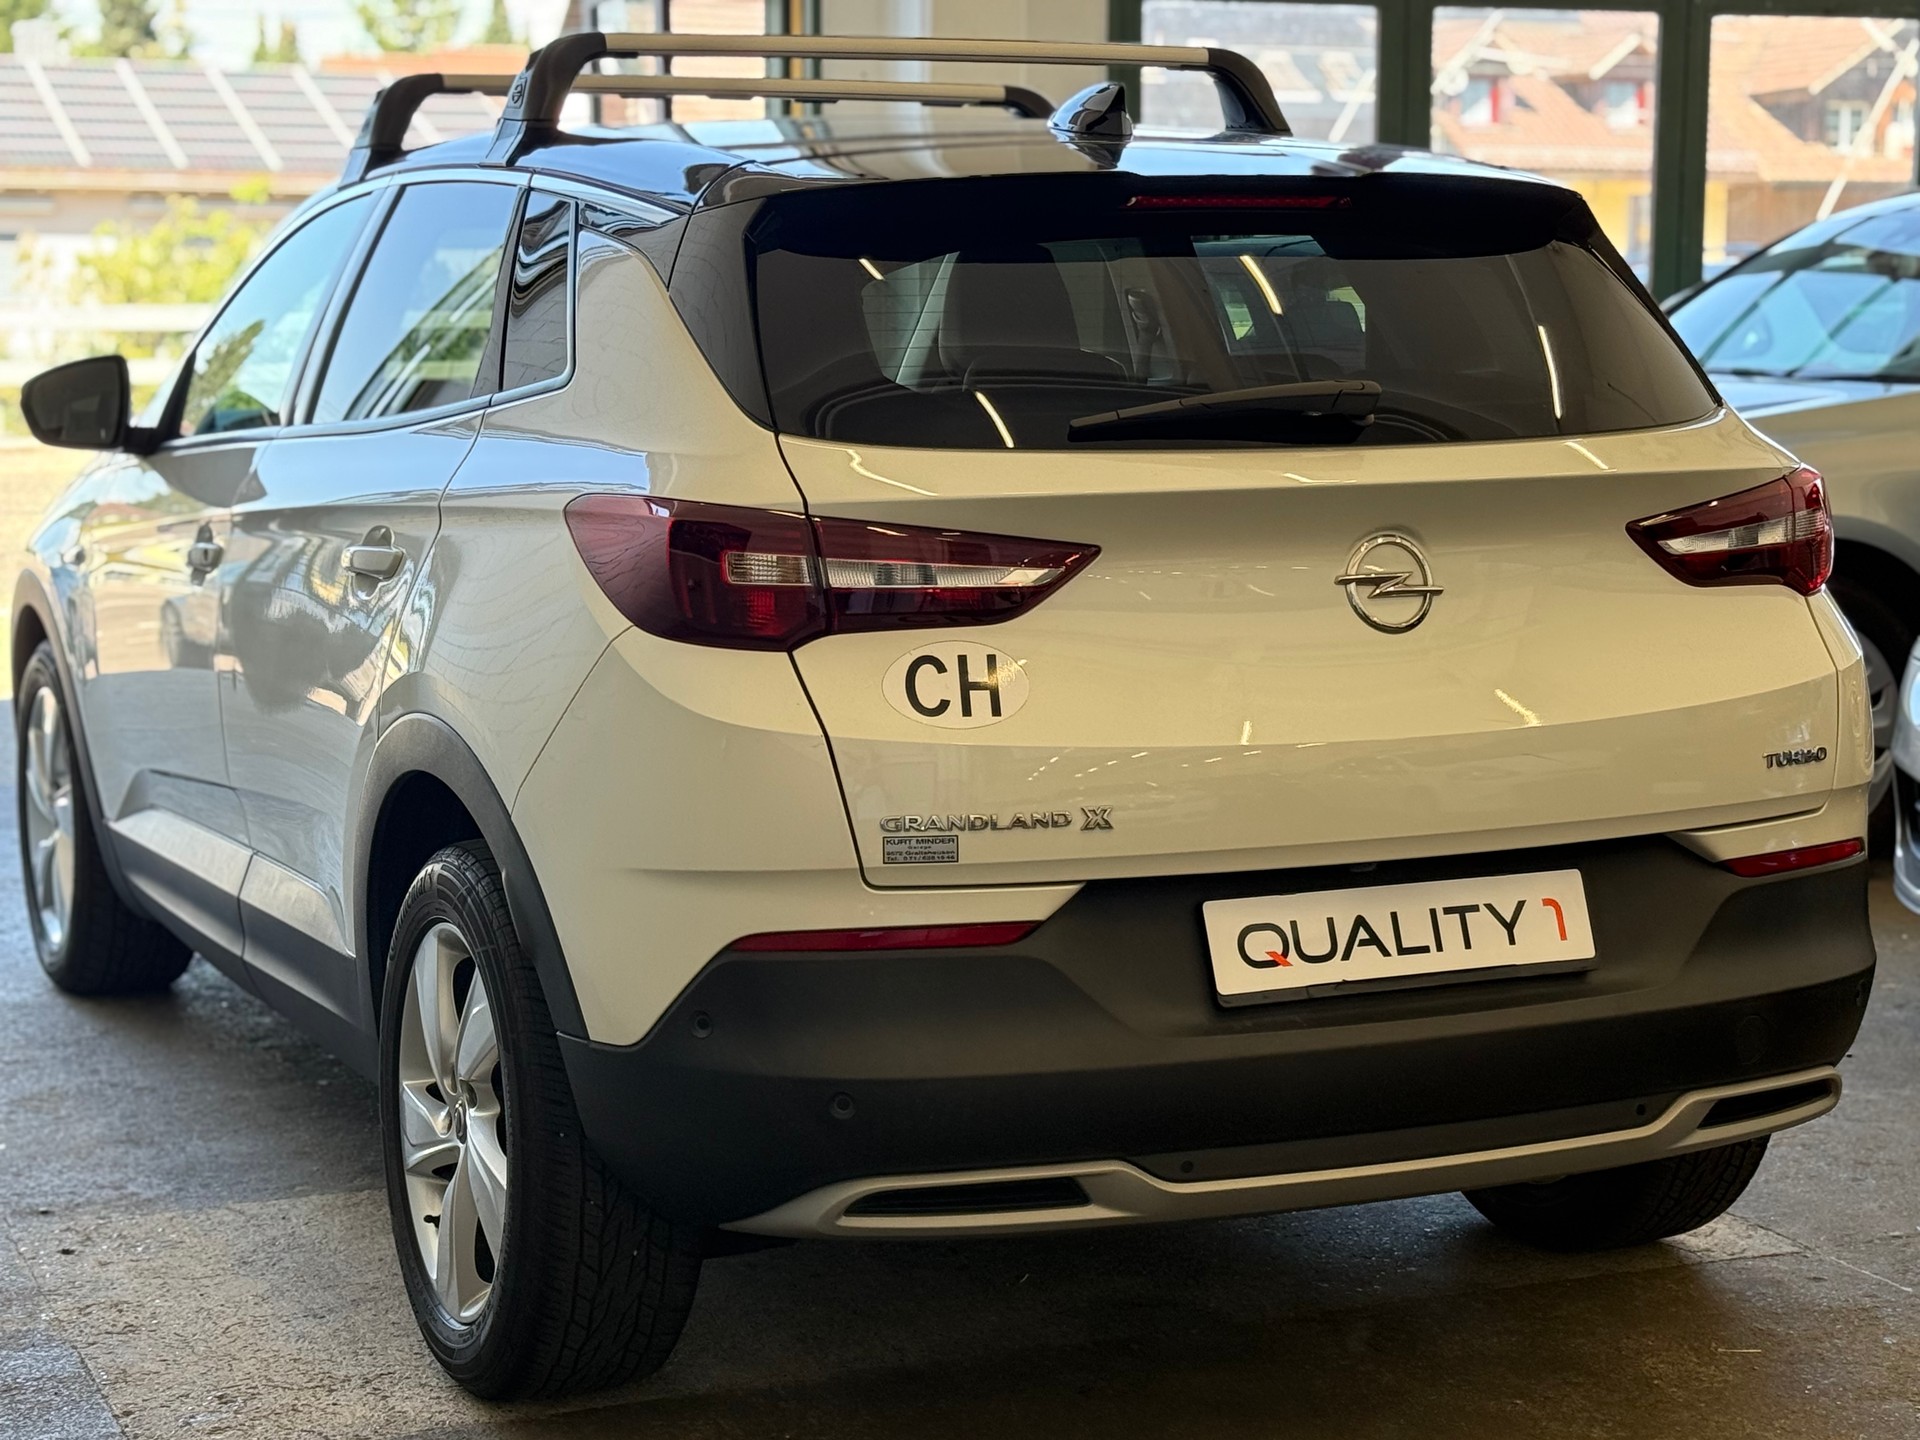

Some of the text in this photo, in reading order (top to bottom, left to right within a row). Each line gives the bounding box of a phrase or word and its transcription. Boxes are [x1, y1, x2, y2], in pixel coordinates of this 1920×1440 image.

[905, 654, 1002, 717] CH
[1762, 747, 1827, 768] TURBO
[880, 805, 1114, 832] GRANDLAND X
[1236, 899, 1527, 970] QUALITY
